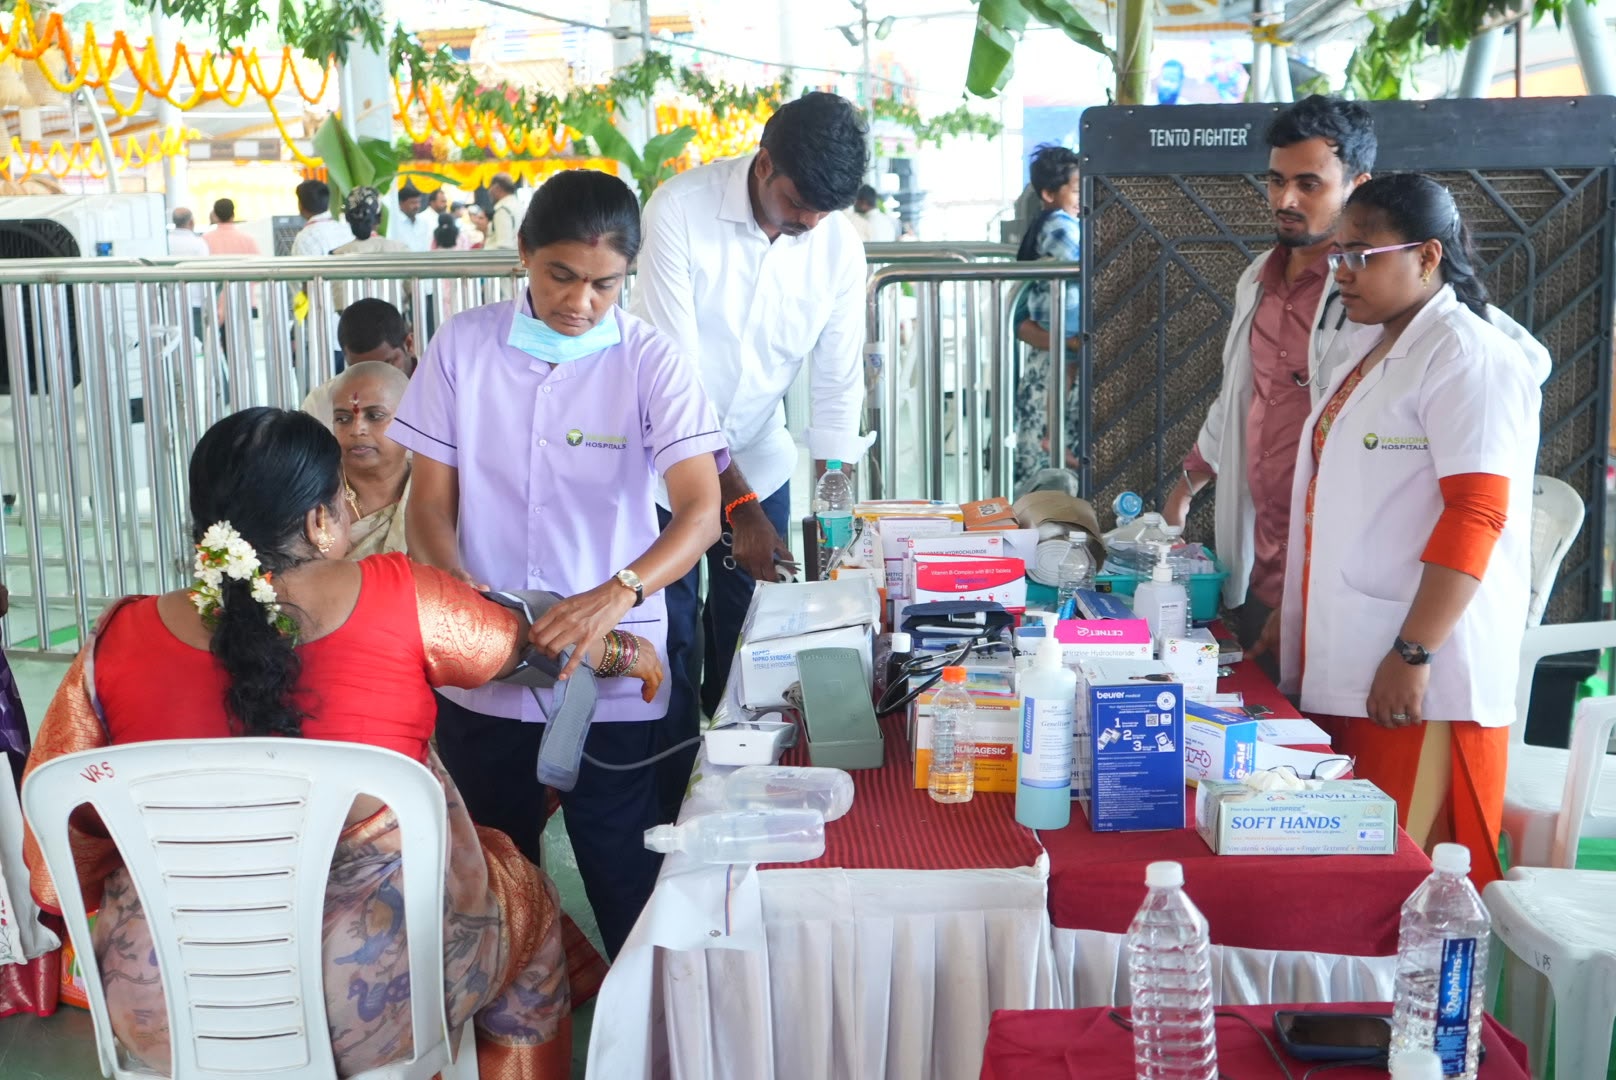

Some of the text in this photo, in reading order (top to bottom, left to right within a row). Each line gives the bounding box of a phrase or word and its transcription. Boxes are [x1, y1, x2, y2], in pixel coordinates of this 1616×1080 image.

[1149, 128, 1248, 147] TENTO FIGHTER
[585, 442, 627, 450] HOSPITALS
[1090, 629, 1124, 637] CETNET
[1091, 649, 1135, 657] Hydrochloride
[1097, 691, 1125, 699] beurer
[1114, 718, 1121, 728] 1
[1123, 730, 1132, 740] 2
[1133, 741, 1142, 751] 3
[1231, 816, 1341, 830] SOFT HANDS
